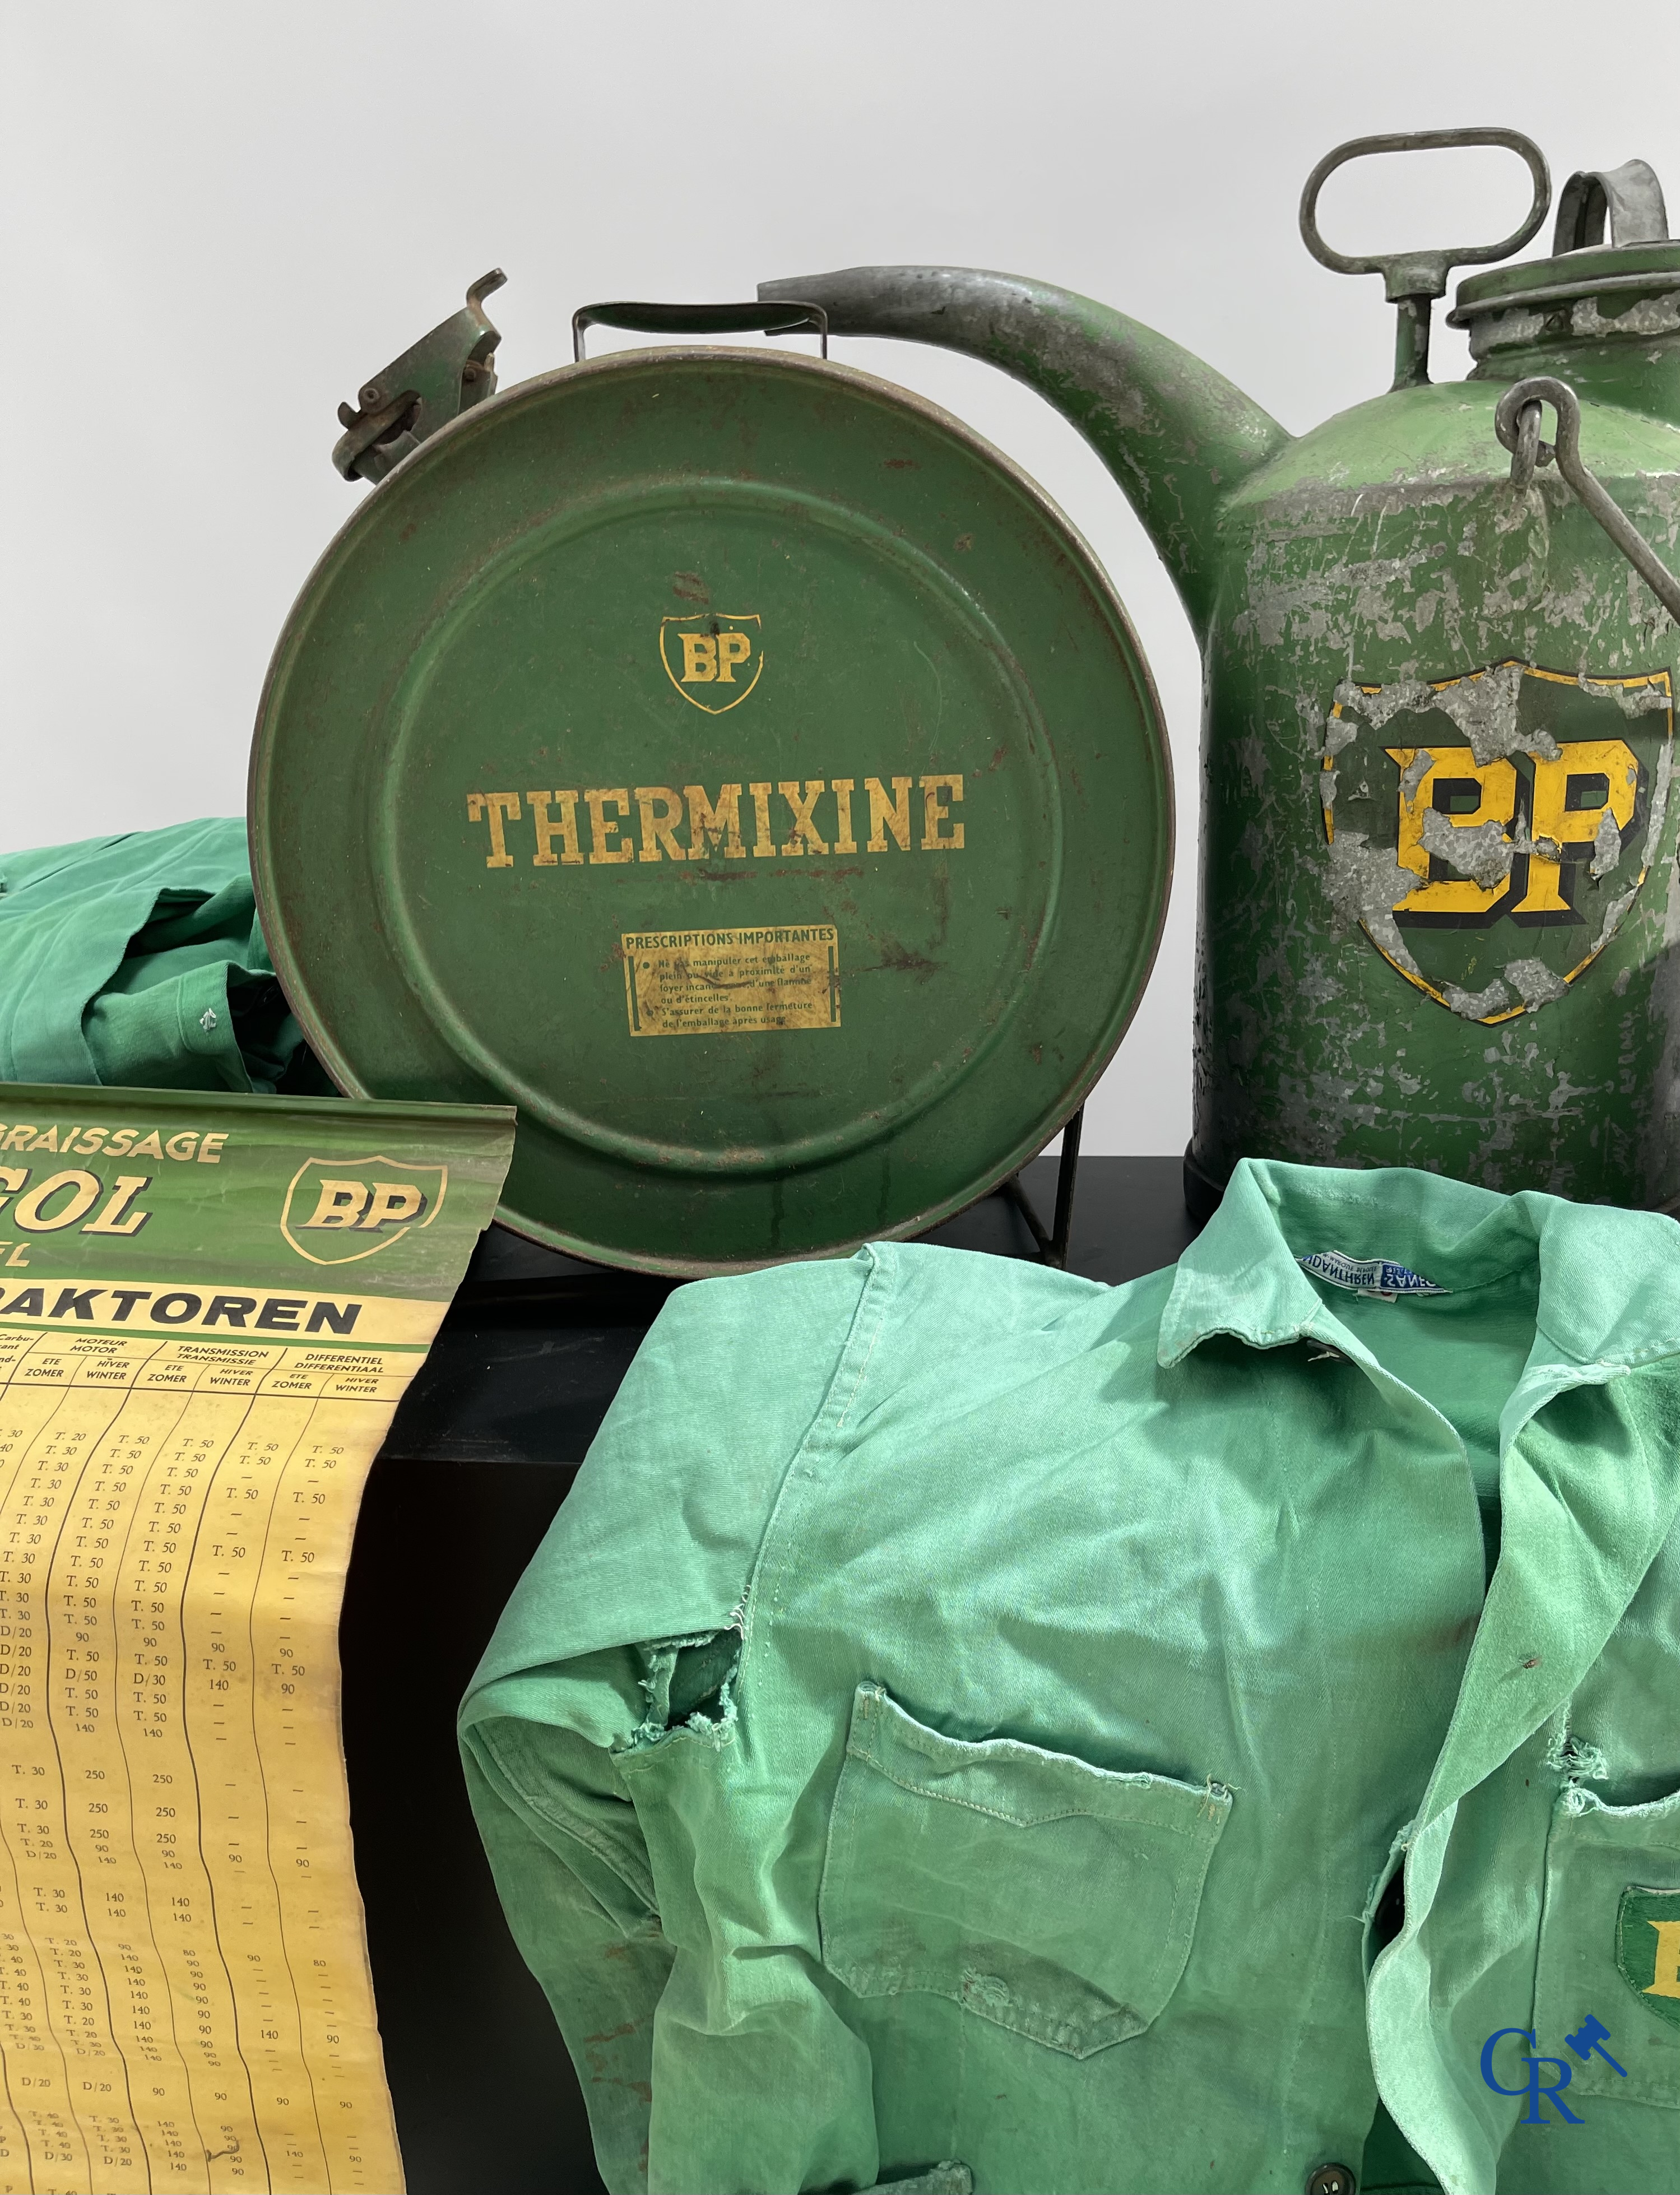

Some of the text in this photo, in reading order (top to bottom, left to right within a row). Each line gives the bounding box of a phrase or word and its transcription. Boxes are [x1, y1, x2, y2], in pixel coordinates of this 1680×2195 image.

[677, 633, 751, 683] BP
[466, 774, 965, 868] THERMIXINE
[1382, 738, 1646, 924] BP
[626, 928, 834, 950] PRESCRIPTIONS IMPORTANTES
[693, 957, 741, 968] manipuler
[660, 984, 684, 994] foyer
[662, 1007, 704, 1017] S'assurer
[708, 1005, 719, 1014] de
[722, 1005, 731, 1013] la
[735, 1004, 763, 1013] bonne
[662, 1019, 674, 1028] de
[296, 1178, 426, 1233] BP
[0, 1287, 363, 1334] AKTOREN
[75, 1338, 128, 1347] MOTEUR
[69, 1345, 118, 1354] MOTOR
[178, 1345, 270, 1358] TRANSMISSION
[177, 1353, 257, 1366] TRANSMISSIE
[304, 1353, 383, 1365] DIFFERENTIEL
[96, 1360, 130, 1369] HIVER
[294, 1362, 384, 1373] DIFFERENTIAAL
[24, 1368, 64, 1377] ZOMER
[86, 1370, 127, 1380] WINTER
[147, 1373, 187, 1383] ZOMER
[210, 1376, 251, 1386] WINTER
[271, 1380, 312, 1390] ZOMER
[336, 1384, 378, 1393] WINTER
[71, 1433, 87, 1441] 20
[134, 1436, 150, 1445] 50
[198, 1440, 214, 1448] 50
[263, 1443, 279, 1451] 50
[329, 1446, 344, 1455] 50
[47, 1479, 62, 1489] 30
[243, 1488, 258, 1500] 50
[311, 1493, 326, 1505] 50
[231, 1547, 246, 1558] 50
[300, 1552, 315, 1563] 50
[76, 1632, 90, 1642] 90
[143, 1637, 157, 1648] 90
[211, 1642, 225, 1653] 90
[280, 1648, 294, 1658] 90
[222, 1660, 236, 1672] 50
[291, 1665, 305, 1676] 50
[210, 1679, 229, 1691] 140
[281, 1683, 295, 1695] 90
[75, 1723, 95, 1733] 140
[143, 1728, 163, 1738] 140
[31, 1766, 45, 1776] 30
[85, 1770, 105, 1780] 250
[152, 1774, 173, 1784] 250
[35, 1799, 48, 1810] 30
[88, 1803, 108, 1813] 250
[156, 1807, 176, 1818] 250
[89, 1829, 109, 1839] 250
[156, 1833, 177, 1844] 250
[95, 1844, 109, 1853] 90
[161, 1849, 175, 1858] 90
[98, 1856, 117, 1864] 140
[228, 1854, 242, 1863] 90
[295, 1858, 309, 1868] 90
[106, 1892, 124, 1902] 140
[171, 1896, 190, 1907] 140
[108, 1908, 126, 1918] 140
[173, 1913, 192, 1923] 140
[247, 1954, 261, 1962] 90
[78, 1987, 91, 1996] 30
[193, 1982, 206, 1991] 90
[130, 1990, 148, 2000] 140
[196, 1996, 208, 2004] 90
[132, 2005, 150, 2015] 140
[197, 2010, 211, 2019] 90
[134, 2020, 151, 2030] 140
[198, 2025, 212, 2035] 90
[136, 2035, 154, 2044] 140
[261, 2029, 279, 2040] 140
[326, 2034, 340, 2044] 90
[152, 2087, 165, 2096] 90
[214, 2092, 228, 2101] 90
[276, 2097, 289, 2106] 90
[168, 2150, 185, 2158] 140
[230, 2155, 242, 2164] 90
[170, 2162, 187, 2171] 140
[231, 2168, 244, 2176] 90
